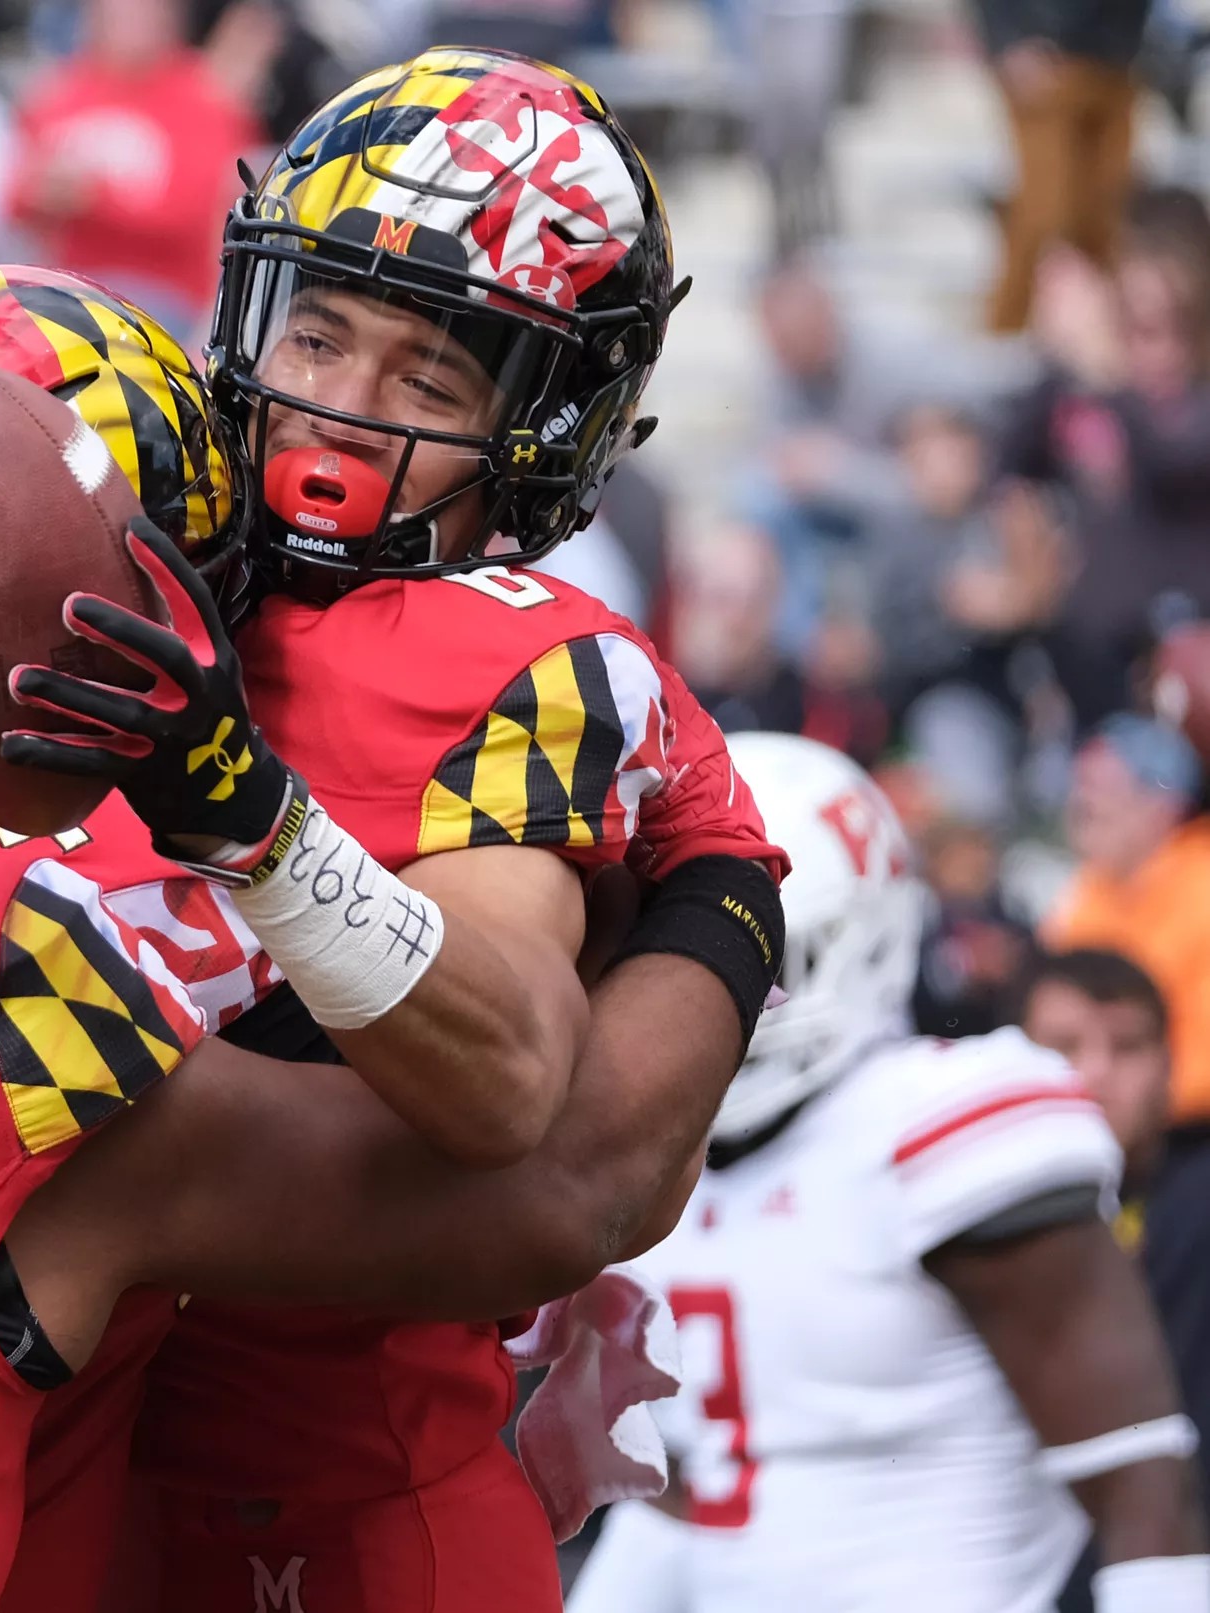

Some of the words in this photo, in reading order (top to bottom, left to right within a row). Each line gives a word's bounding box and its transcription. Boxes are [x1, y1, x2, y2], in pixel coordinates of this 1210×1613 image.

[372, 213, 419, 256] M
[286, 533, 348, 557] Riddell
[270, 797, 306, 862] ATTITUDE
[290, 809, 435, 966] #393
[721, 895, 772, 965] MARYLAND
